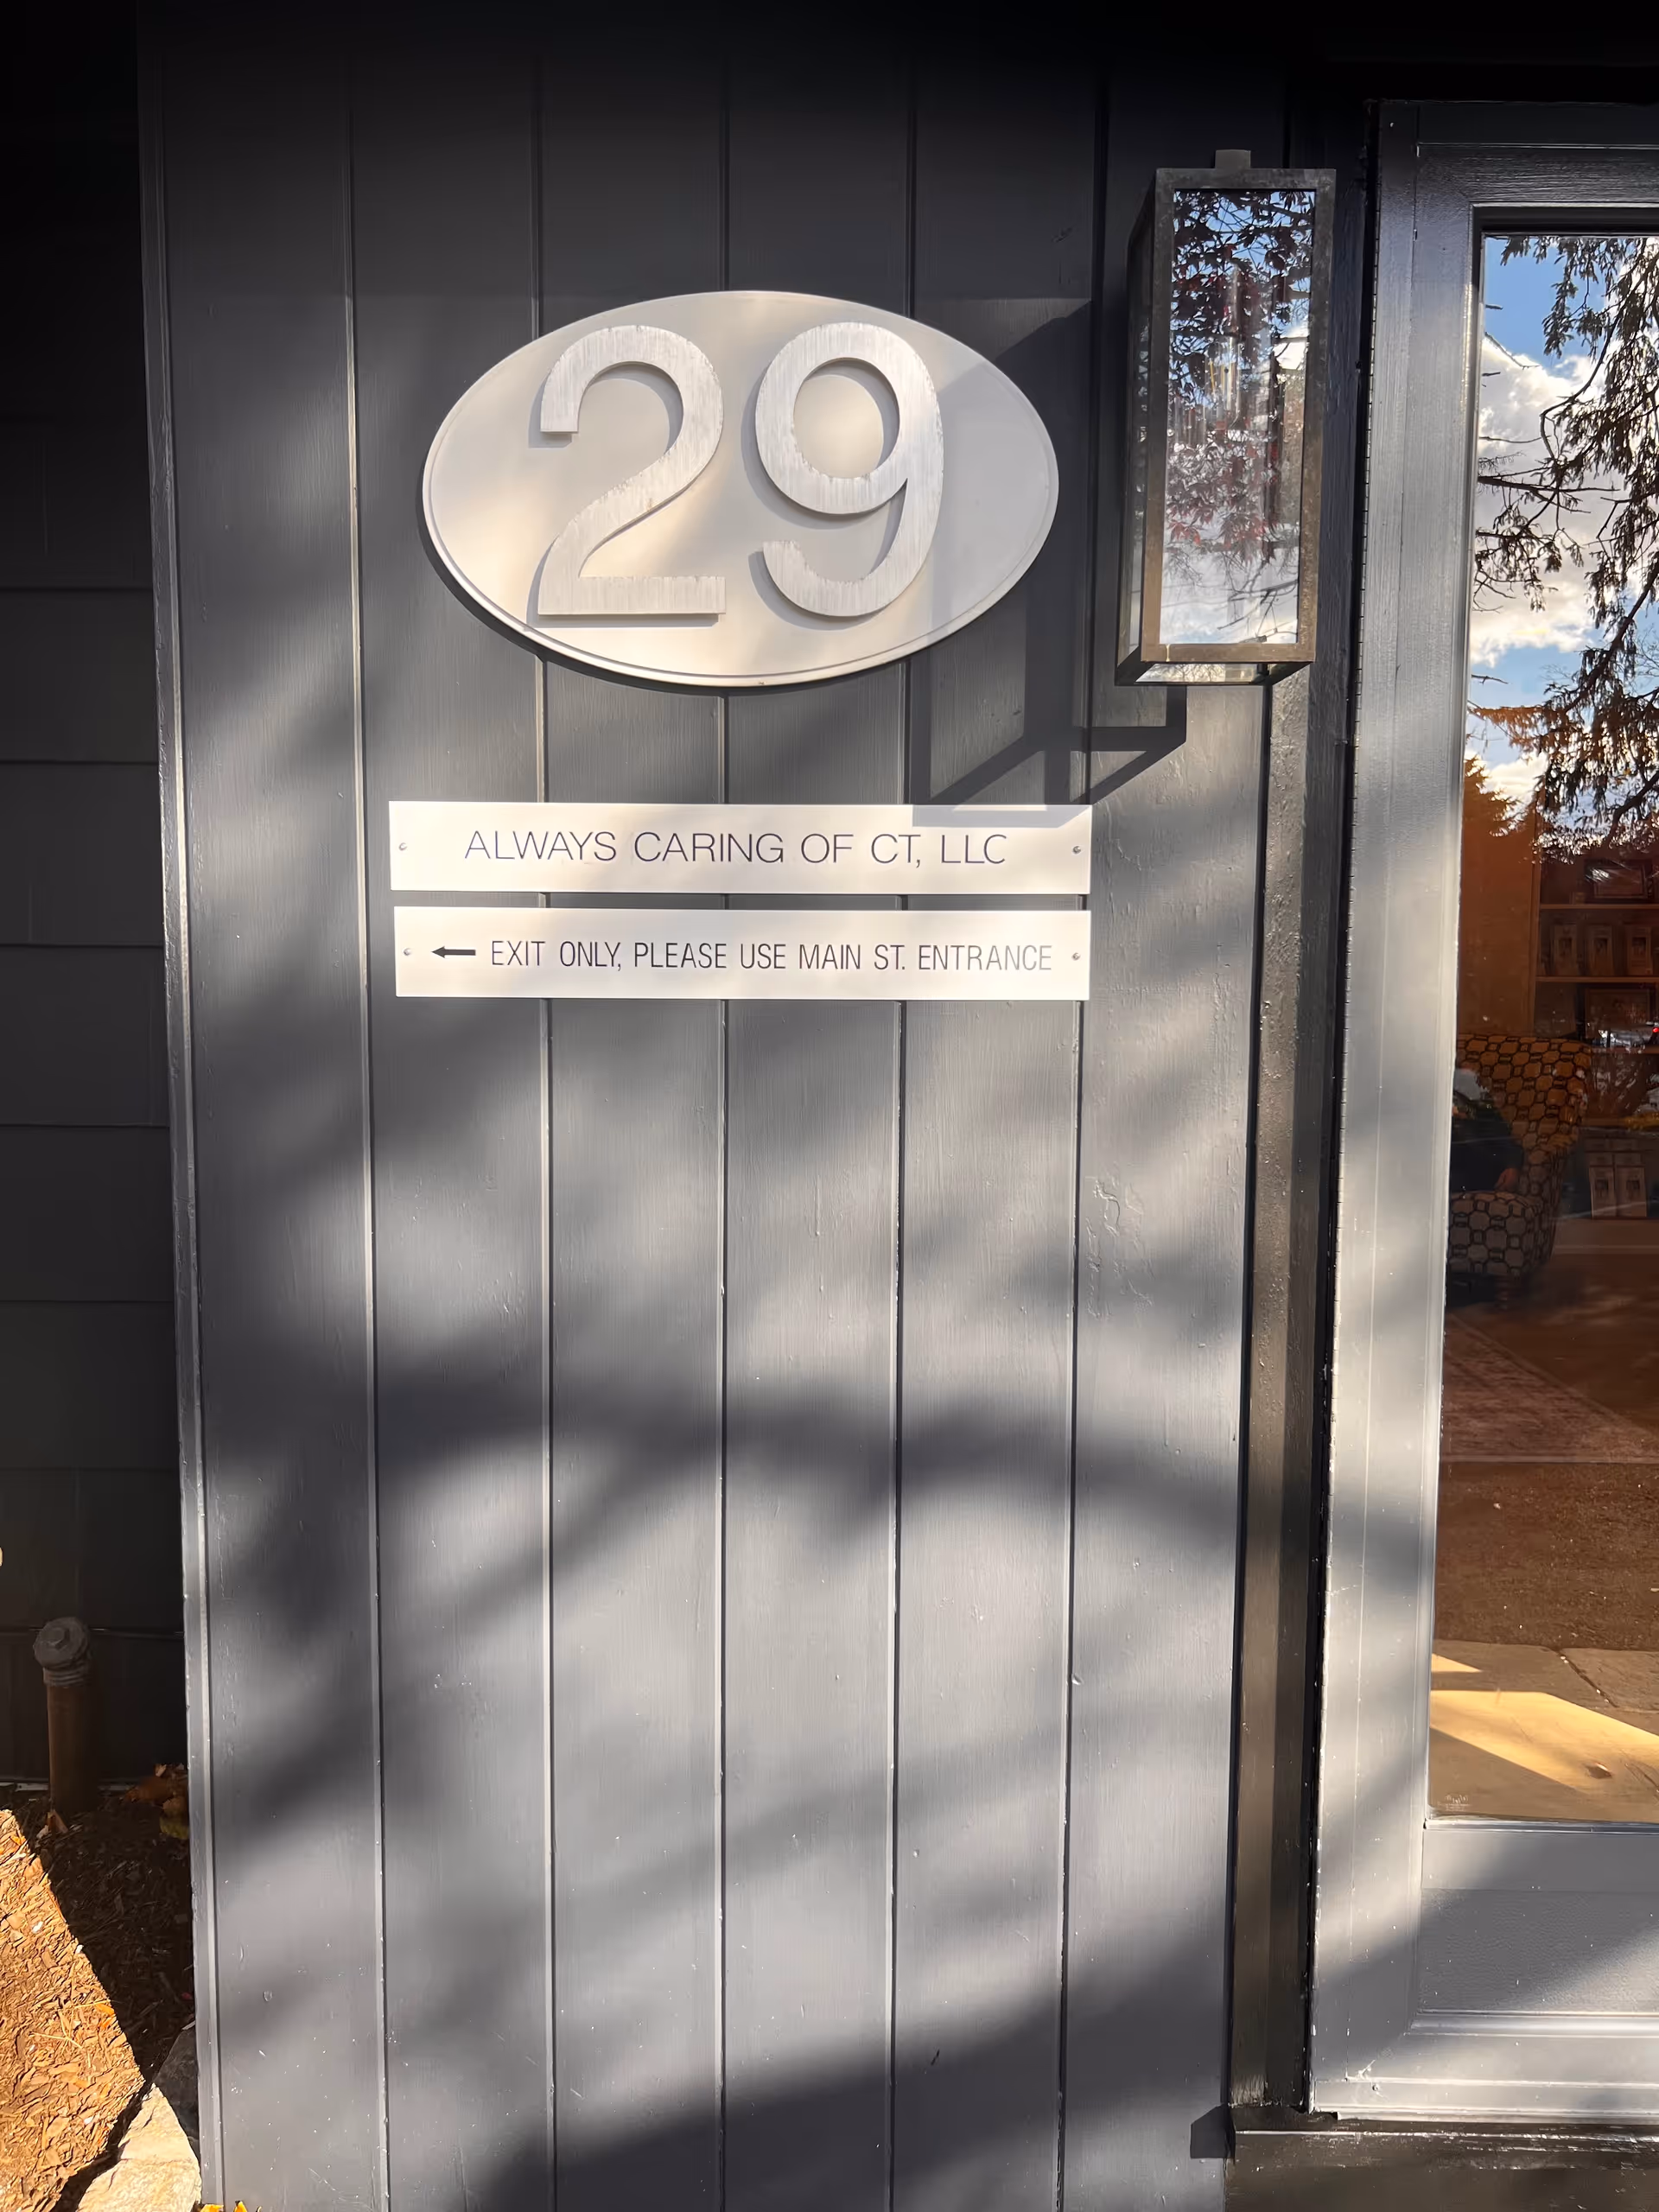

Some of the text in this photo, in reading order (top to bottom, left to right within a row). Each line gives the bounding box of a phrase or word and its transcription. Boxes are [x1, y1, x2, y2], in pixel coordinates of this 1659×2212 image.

[537, 321, 944, 618] 29
[464, 830, 1007, 868] ALWAYS CARING OF CT, LLC
[491, 940, 1052, 971] EXIT ONLY, PLEASE USE MAIN ST. ENTRANCE
